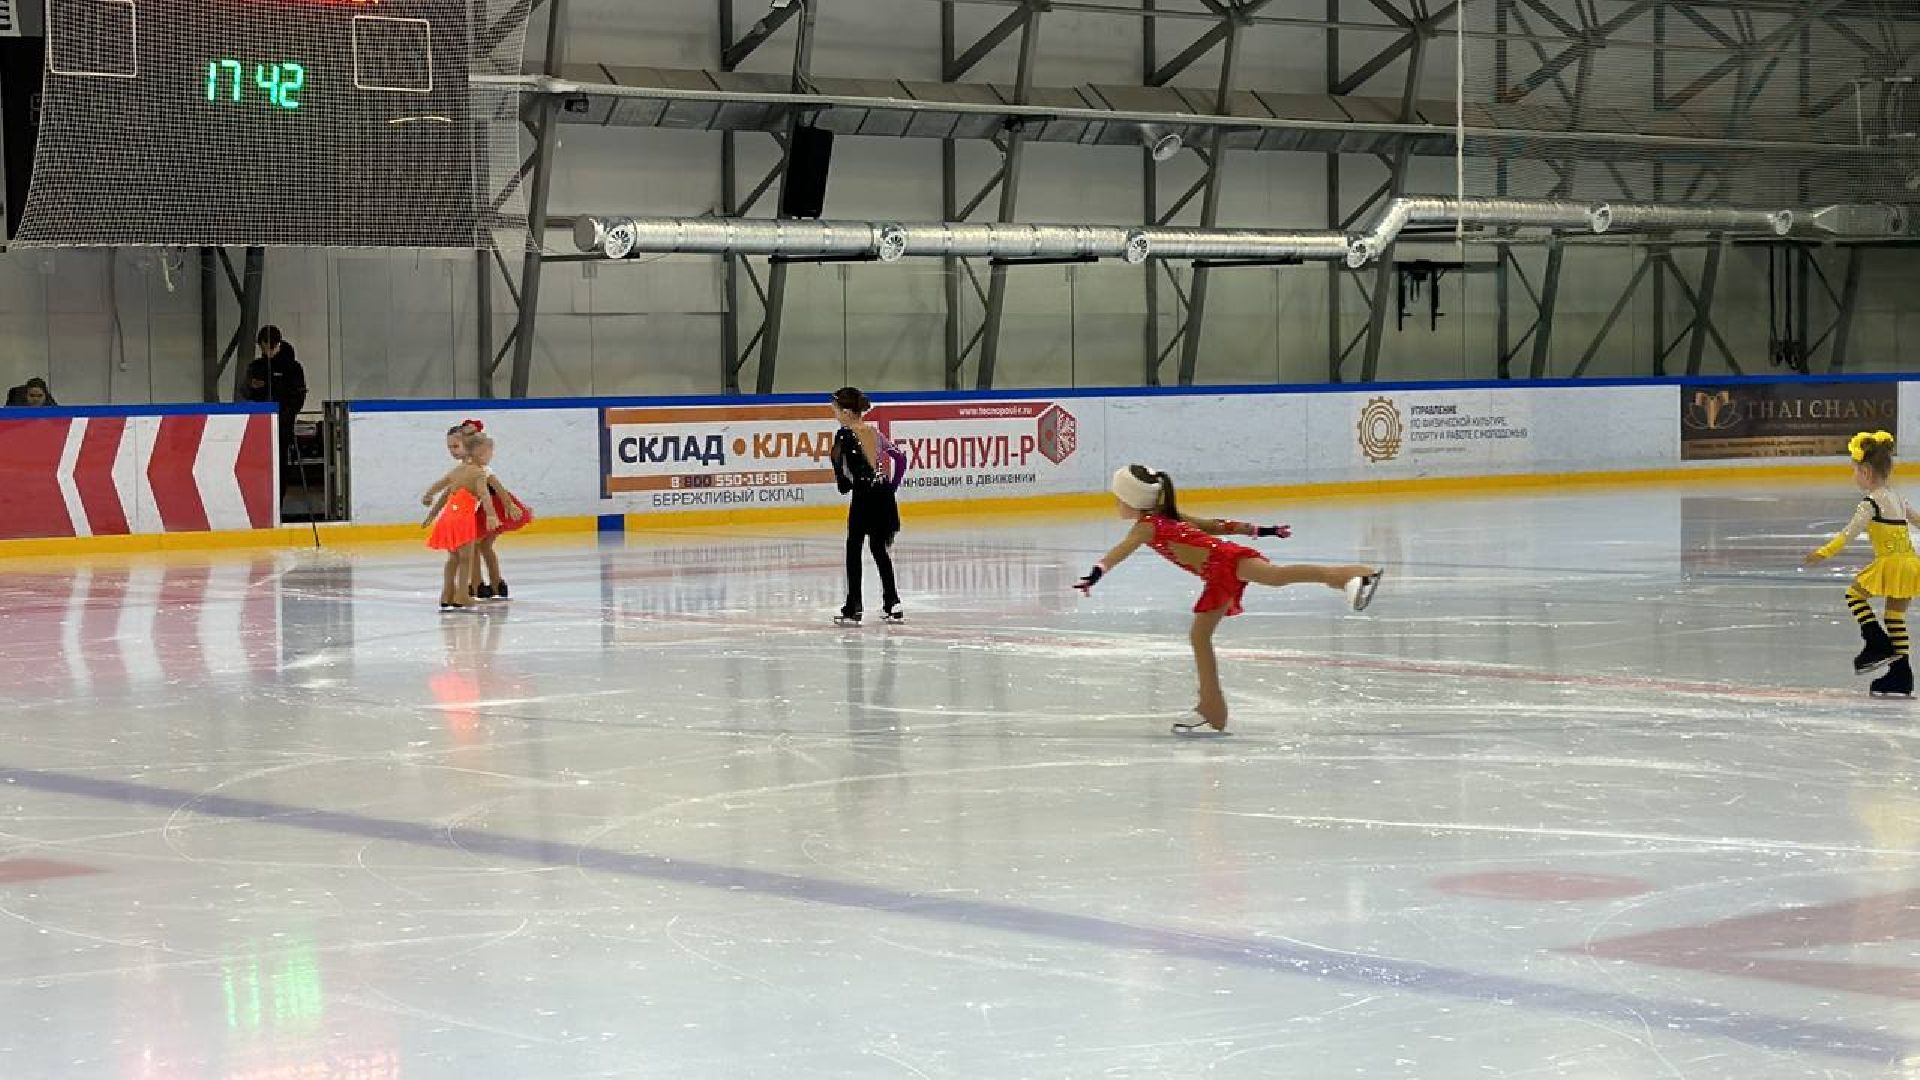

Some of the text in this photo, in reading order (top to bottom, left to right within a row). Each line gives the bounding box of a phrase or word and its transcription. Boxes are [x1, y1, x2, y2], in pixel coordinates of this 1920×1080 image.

[207, 59, 304, 107] 17 42
[1748, 399, 1895, 419] THAI CHANG
[618, 434, 725, 466] СКЛАД
[753, 431, 833, 463] КЛАД
[901, 474, 962, 488] нновации
[653, 486, 805, 507] БЕРЕЖЛИВЫЙ СКЛАД
